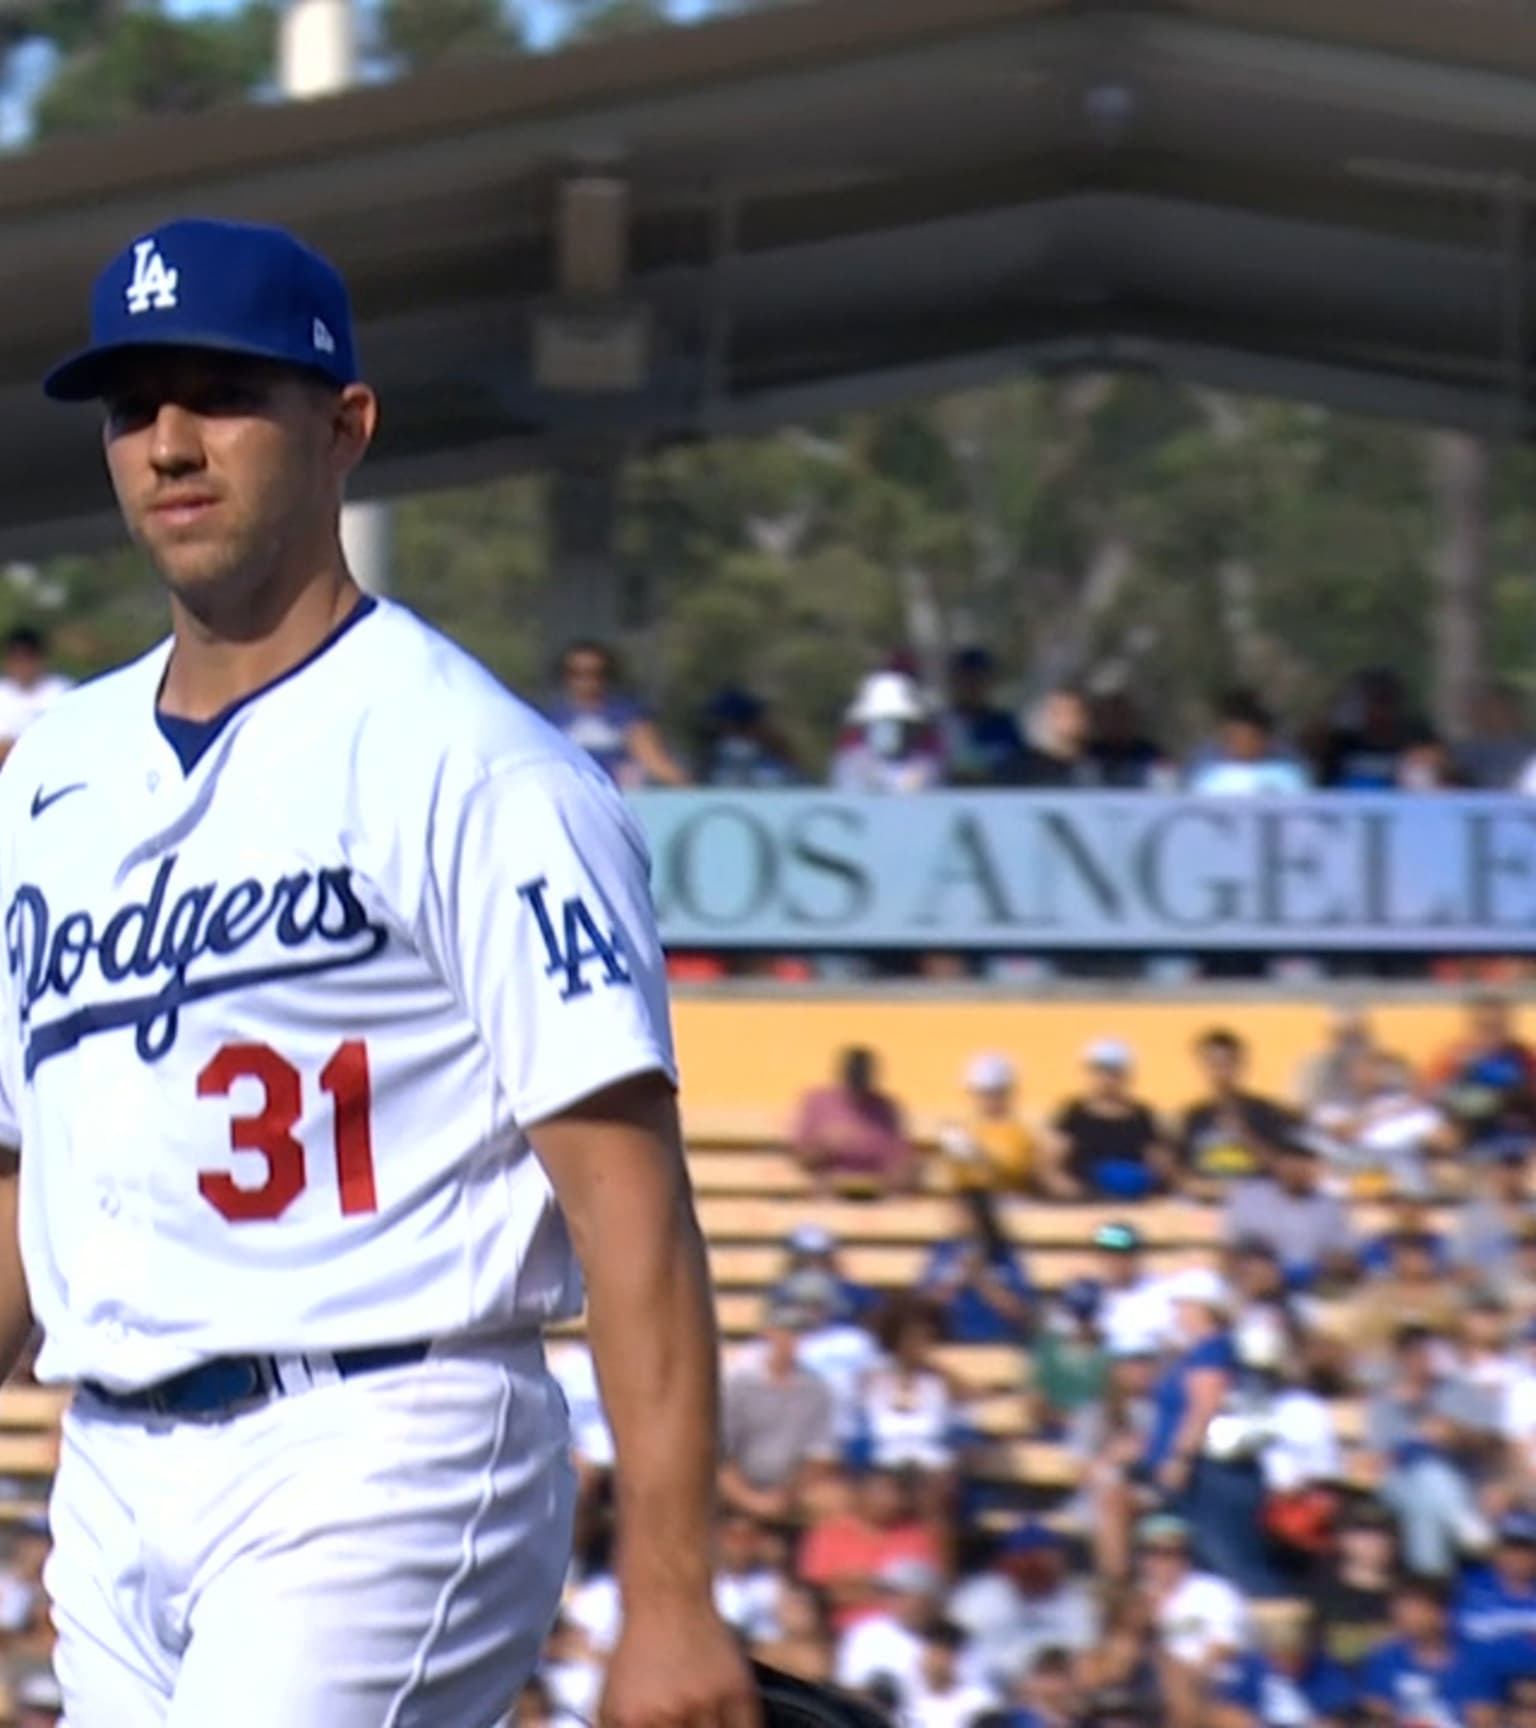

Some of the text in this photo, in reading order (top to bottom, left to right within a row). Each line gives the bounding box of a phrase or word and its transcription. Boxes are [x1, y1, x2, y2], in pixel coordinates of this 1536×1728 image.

[126, 239, 178, 314] LA
[652, 803, 1536, 930] OS ANGELE
[5, 853, 388, 1064] Dodgers
[516, 875, 633, 1003] LA
[196, 1038, 378, 1224] 31
